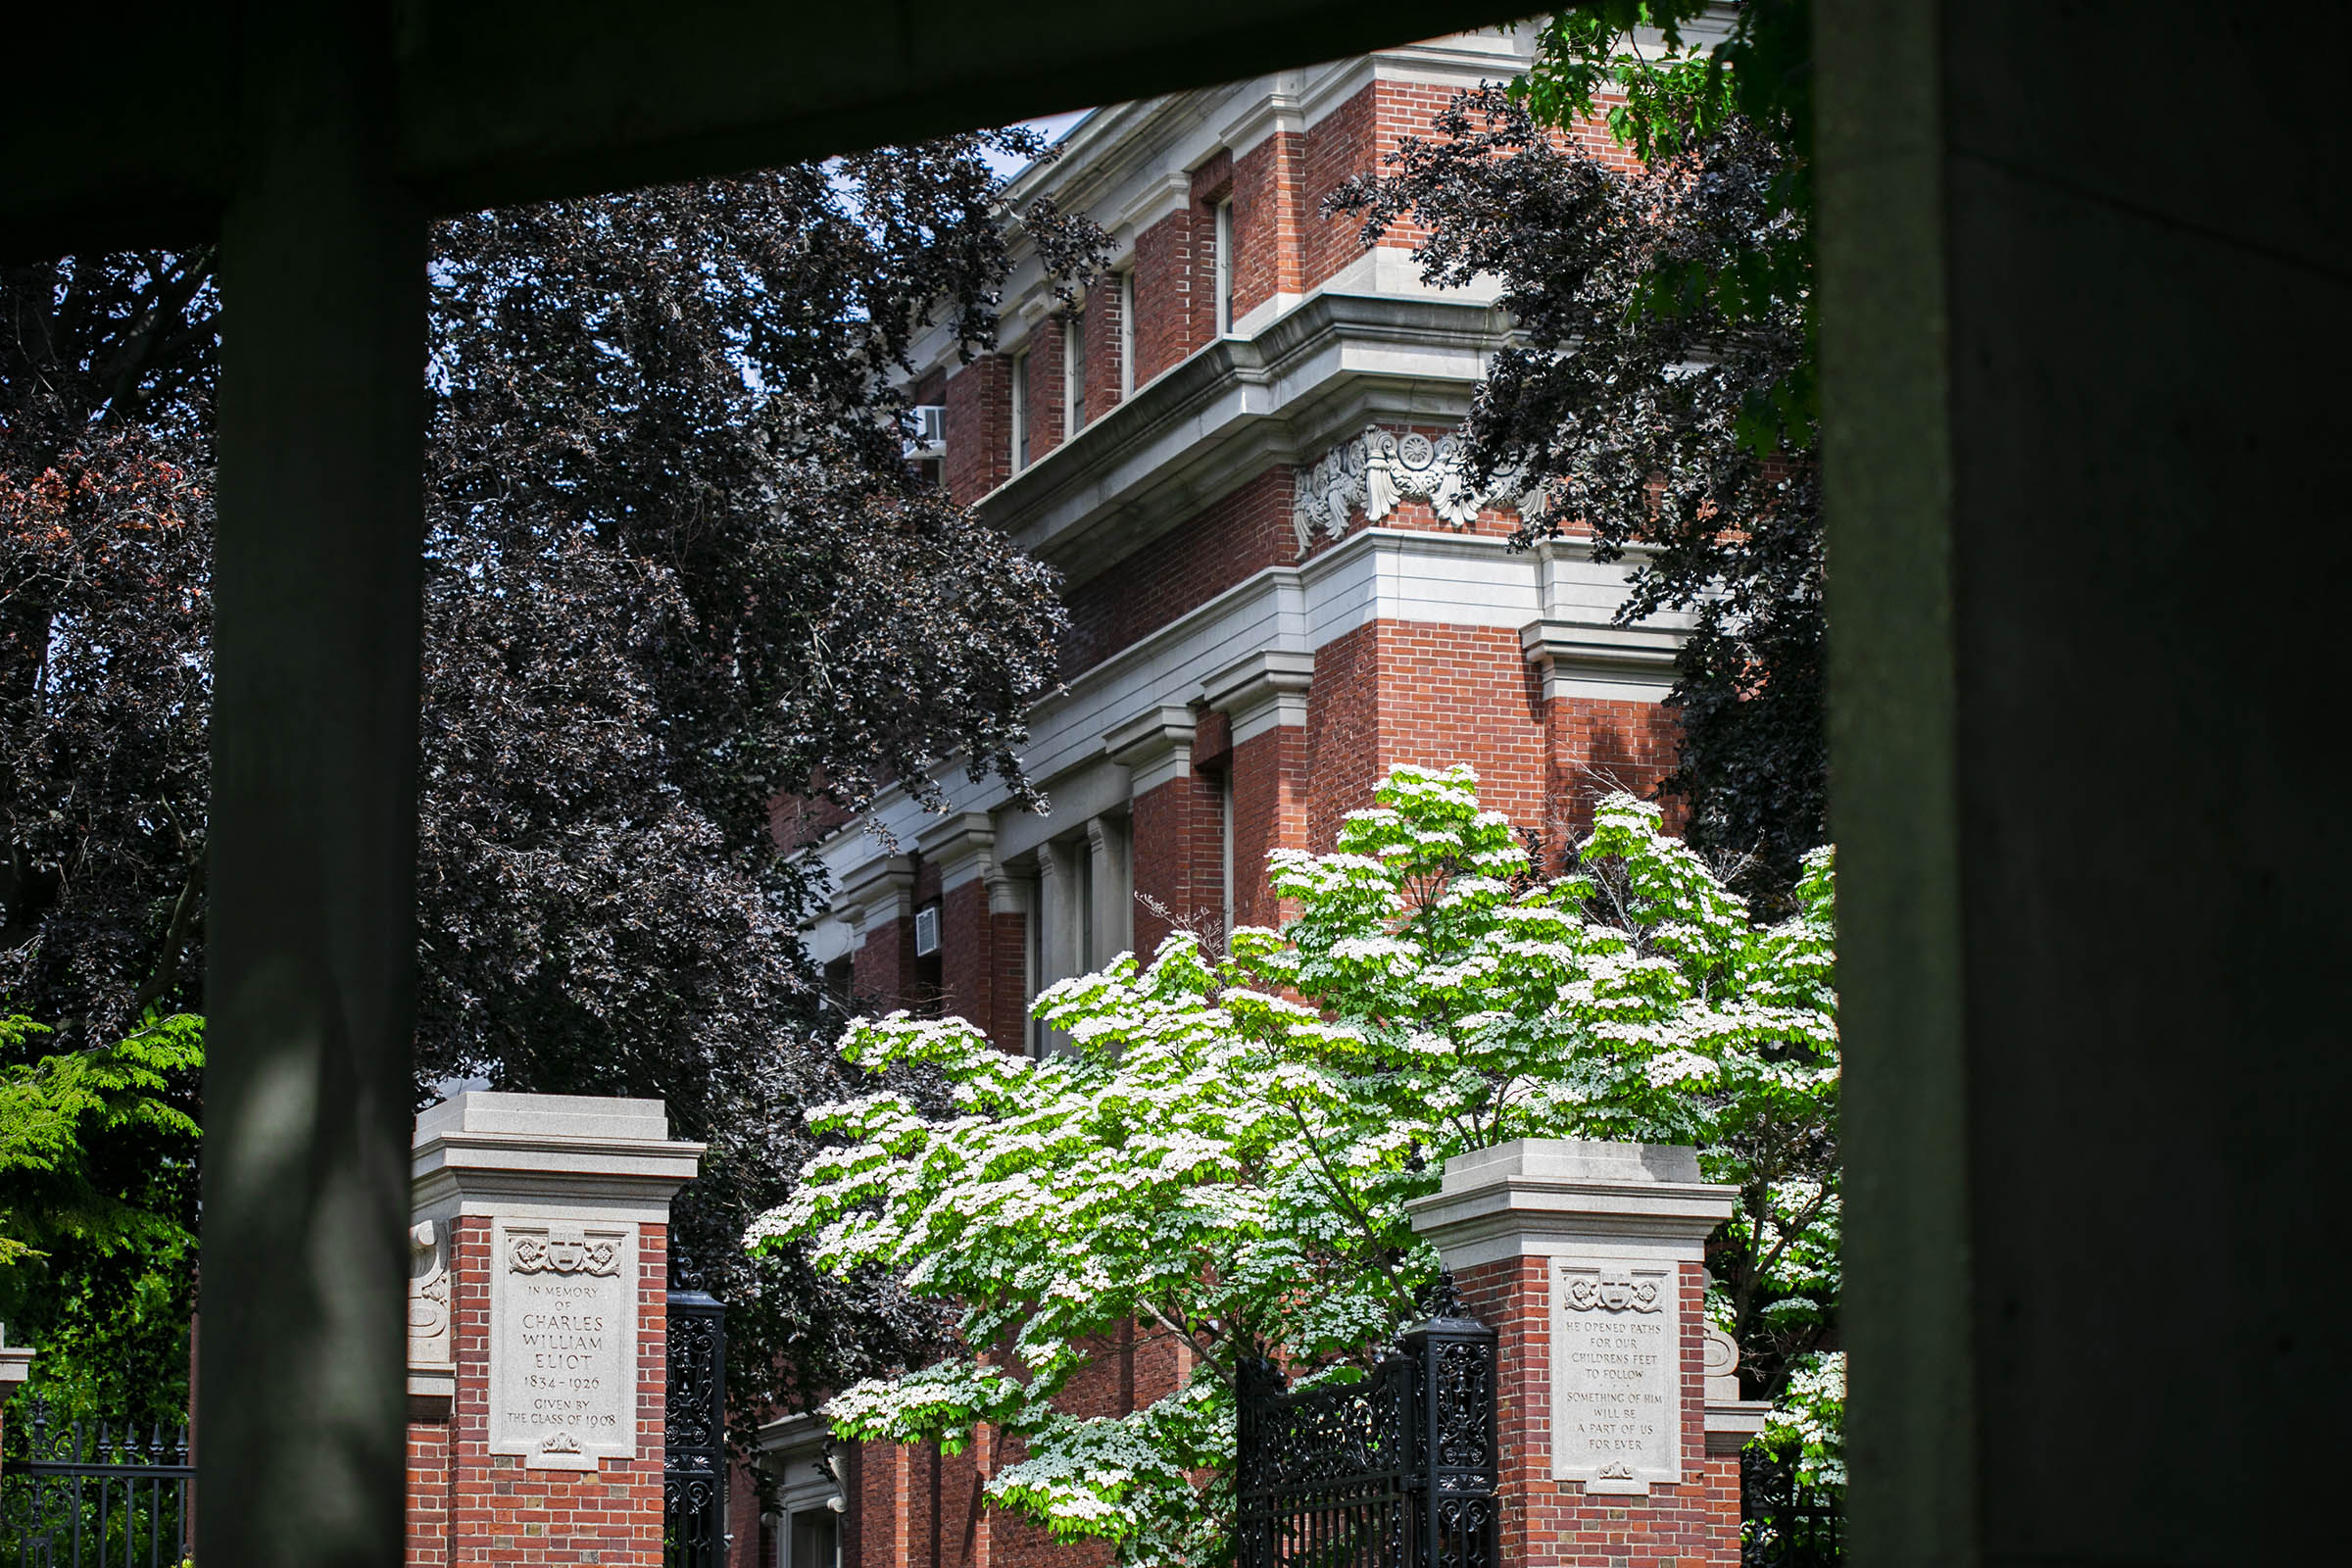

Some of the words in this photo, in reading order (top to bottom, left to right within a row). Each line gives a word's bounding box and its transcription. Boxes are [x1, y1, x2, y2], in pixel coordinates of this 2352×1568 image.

[528, 1286, 541, 1295] IN
[545, 1286, 598, 1298] MEMORY
[555, 1301, 571, 1311] OF
[522, 1314, 603, 1331] CHARLES
[1566, 1321, 1580, 1332] HE
[1585, 1322, 1626, 1333] OPENED
[1631, 1323, 1661, 1334] PATHS
[522, 1334, 603, 1350] WILLIAM
[1590, 1338, 1612, 1348] FOR
[1615, 1338, 1638, 1348] OUR
[535, 1353, 592, 1369] ELIOT
[1571, 1352, 1629, 1364] CHILDRENS
[1633, 1354, 1658, 1365] FEET
[1585, 1368, 1599, 1379] TO
[1603, 1369, 1644, 1380] FOLLOW
[1567, 1392, 1625, 1403] SOMETHING
[1628, 1393, 1642, 1403] OF
[1643, 1394, 1662, 1404] HIM
[534, 1398, 571, 1410] GIVEN
[575, 1400, 590, 1411] BY
[1593, 1408, 1620, 1418] WILL
[1623, 1409, 1637, 1419] BE
[507, 1412, 527, 1423] THE
[530, 1413, 564, 1425] CLASS
[567, 1414, 582, 1425] OF
[586, 1414, 615, 1428] 1908
[1577, 1424, 1585, 1433] A
[1590, 1424, 1616, 1434] PART
[1621, 1424, 1635, 1434] OF
[1641, 1424, 1653, 1435] US
[1589, 1439, 1610, 1450] FOR
[1614, 1440, 1642, 1450] EVER
